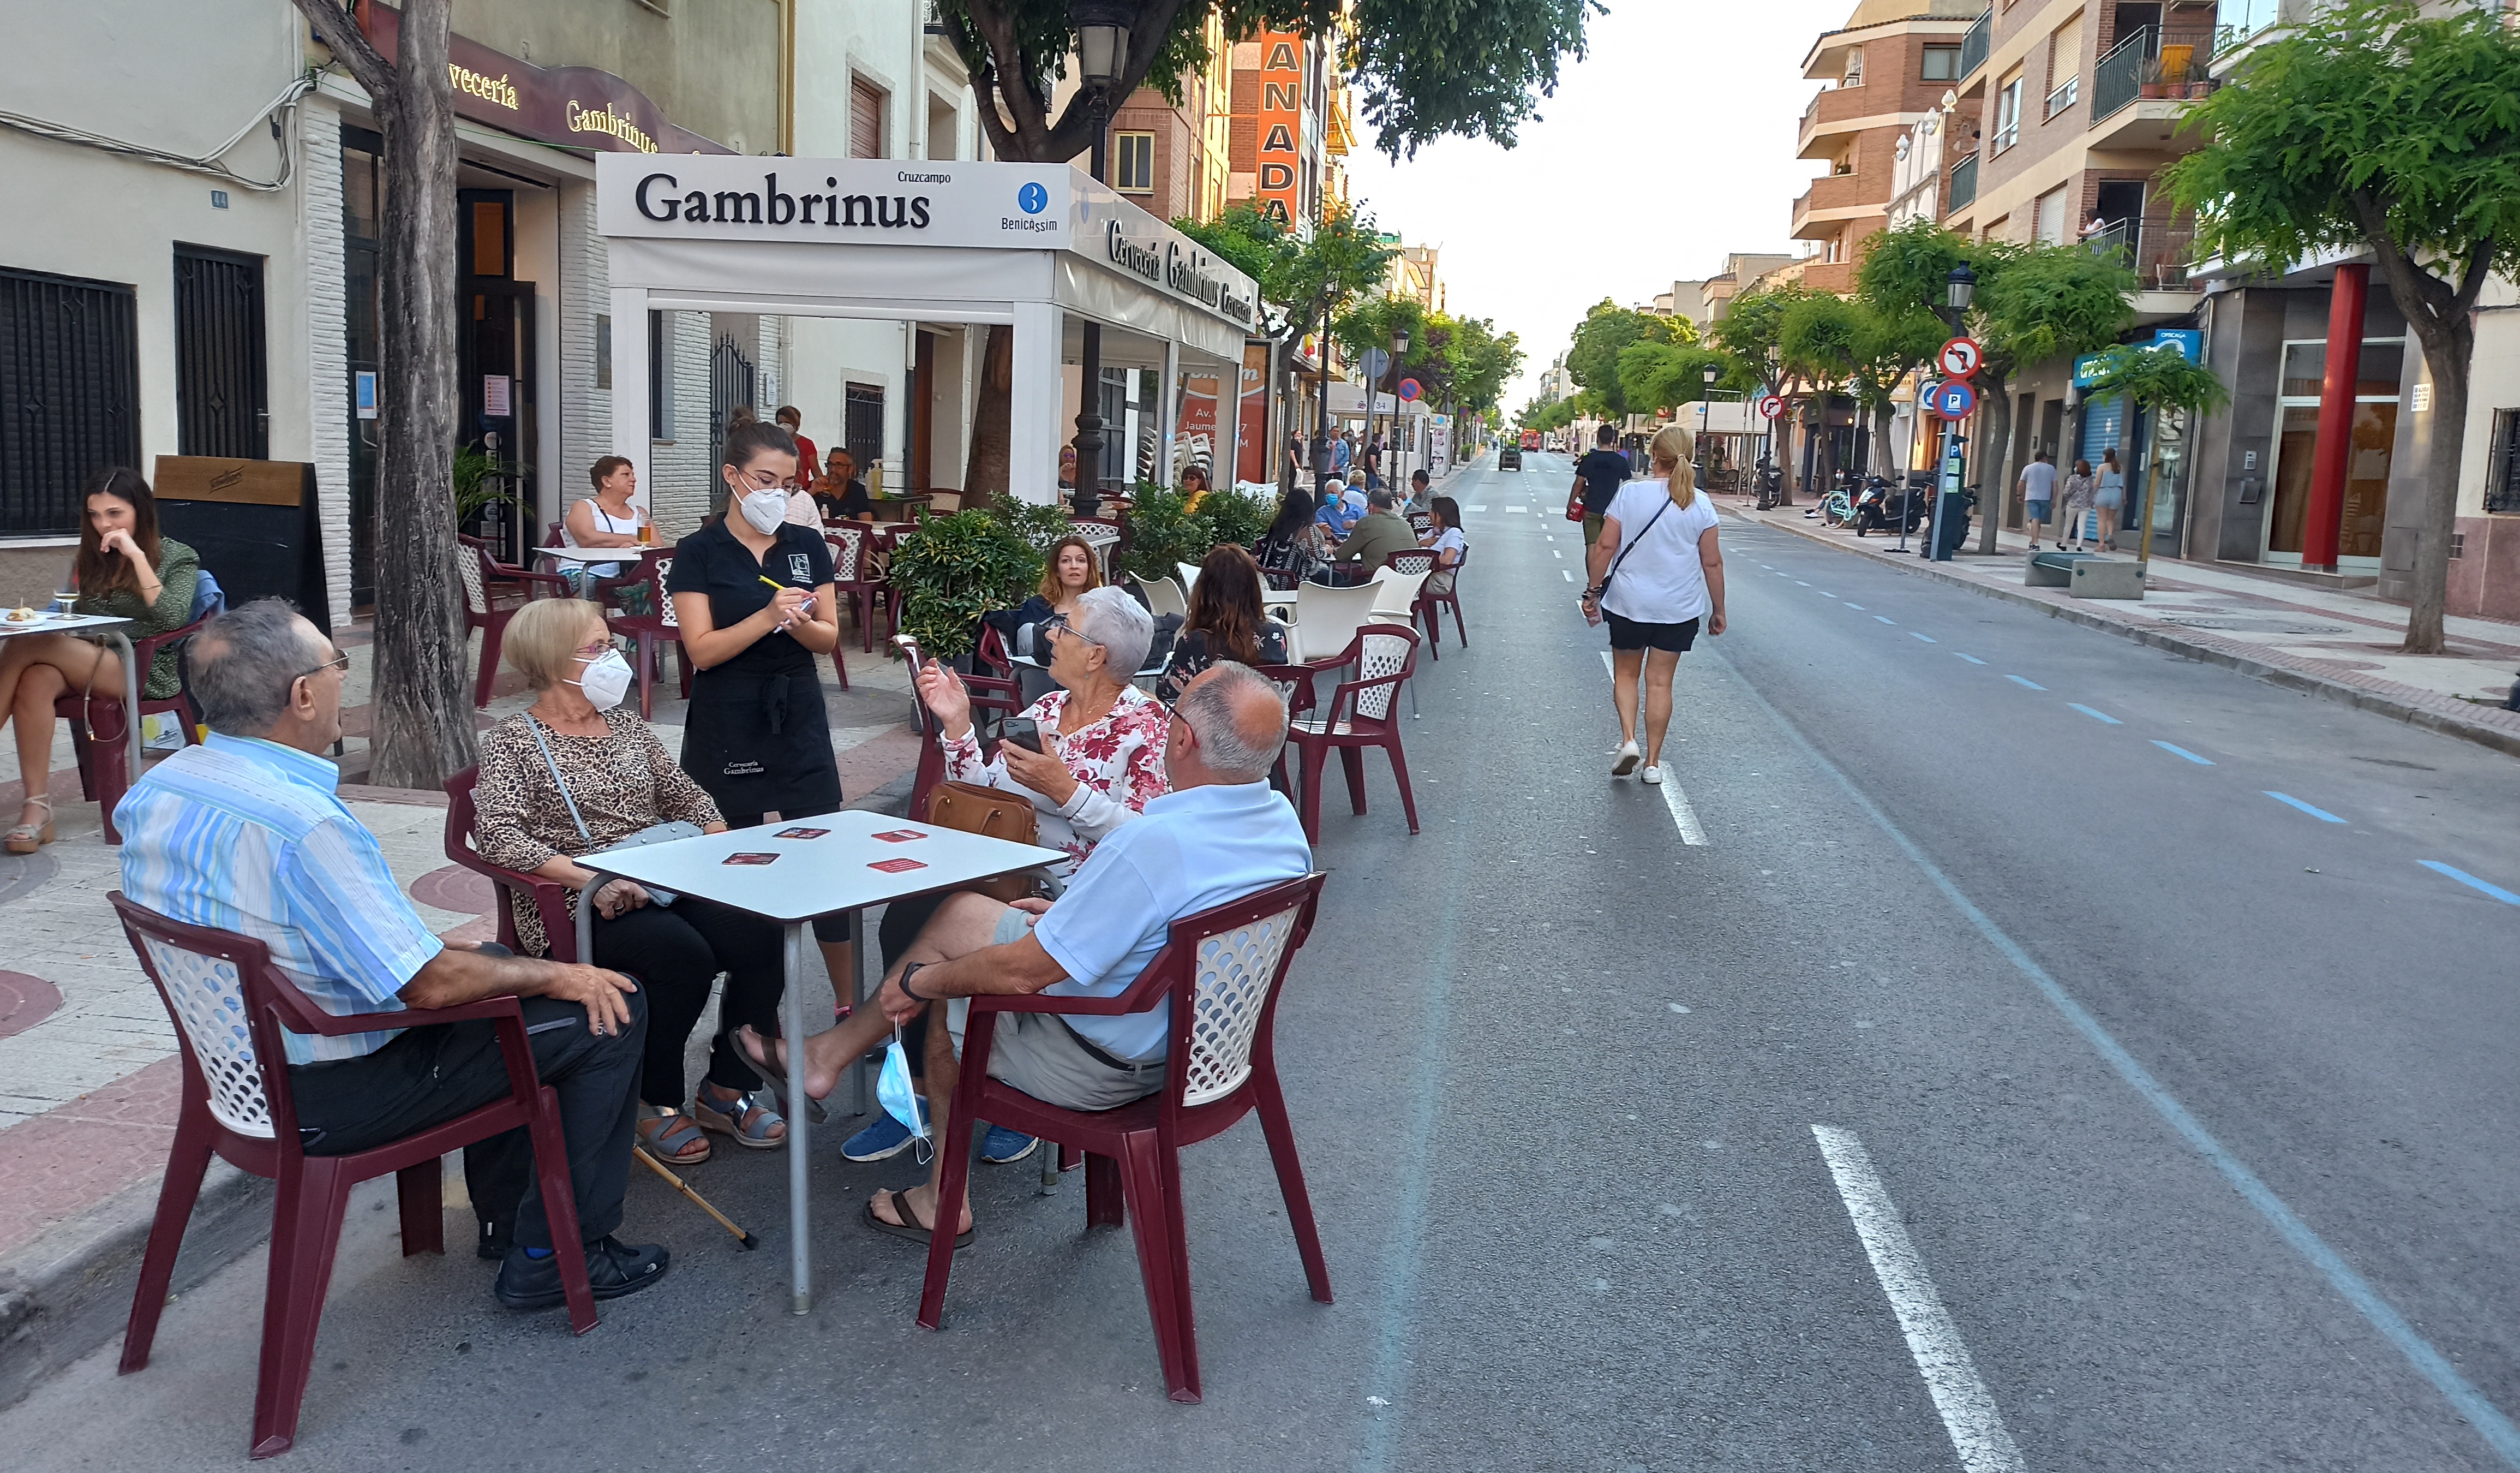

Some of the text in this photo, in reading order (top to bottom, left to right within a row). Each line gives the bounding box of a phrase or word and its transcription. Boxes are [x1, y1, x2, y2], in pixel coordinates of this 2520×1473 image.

[898, 171, 951, 184] Cruzcampo
[214, 192, 226, 207] 44
[635, 172, 930, 229] Gambrinus
[1166, 240, 1219, 307] Gambrinus
[1950, 396, 1958, 404] P
[1195, 408, 1211, 418] Av.
[1185, 421, 1216, 431] Jaume
[1950, 445, 1959, 456] P
